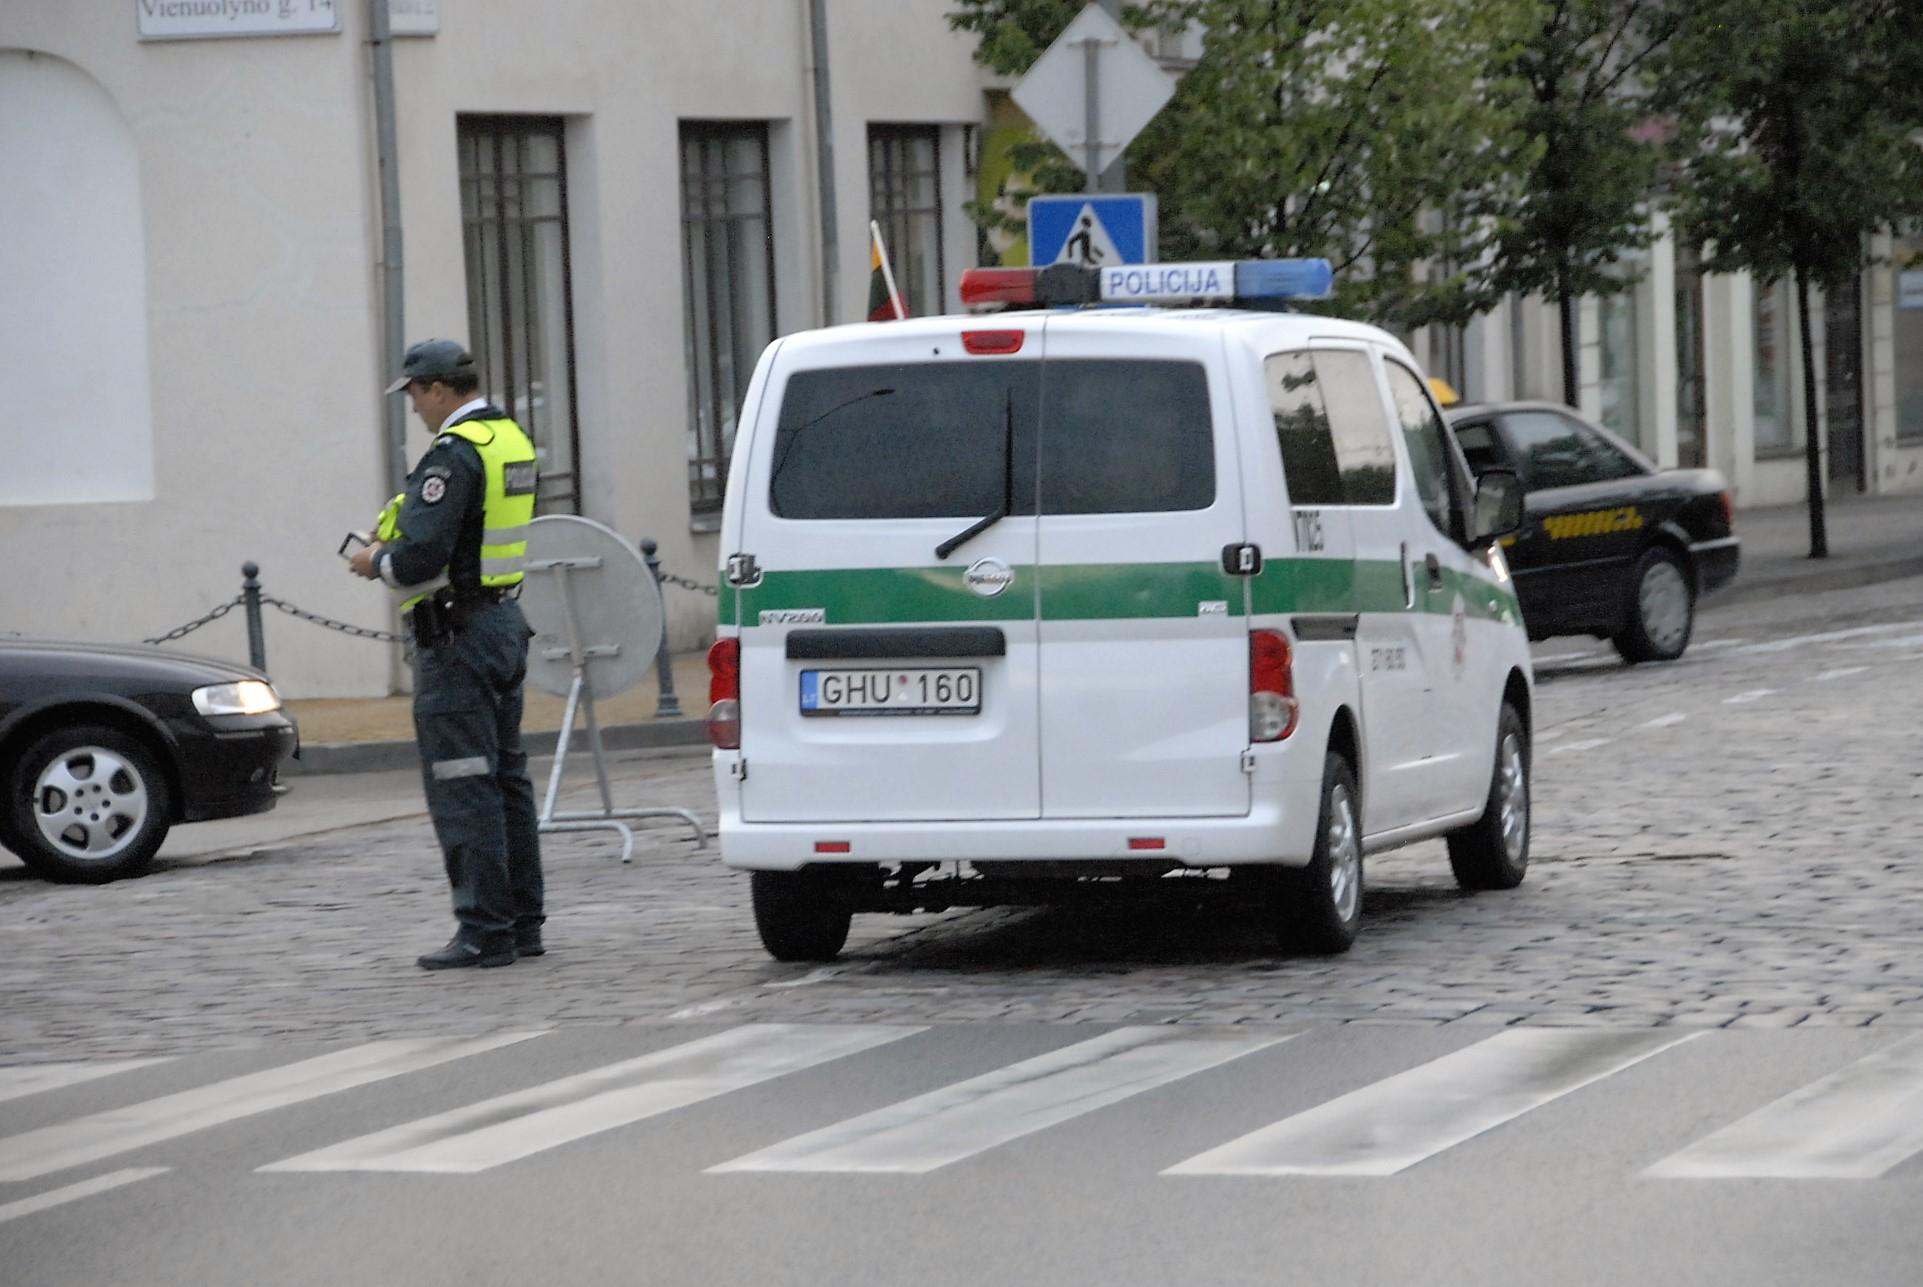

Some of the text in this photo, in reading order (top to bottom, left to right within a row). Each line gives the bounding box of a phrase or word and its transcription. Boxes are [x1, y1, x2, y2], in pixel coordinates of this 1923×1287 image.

[143, 0, 269, 20] Vienuolyno
[279, 0, 296, 18] g.
[1109, 270, 1220, 295] POLICIJA
[823, 674, 972, 704] GHU 160
